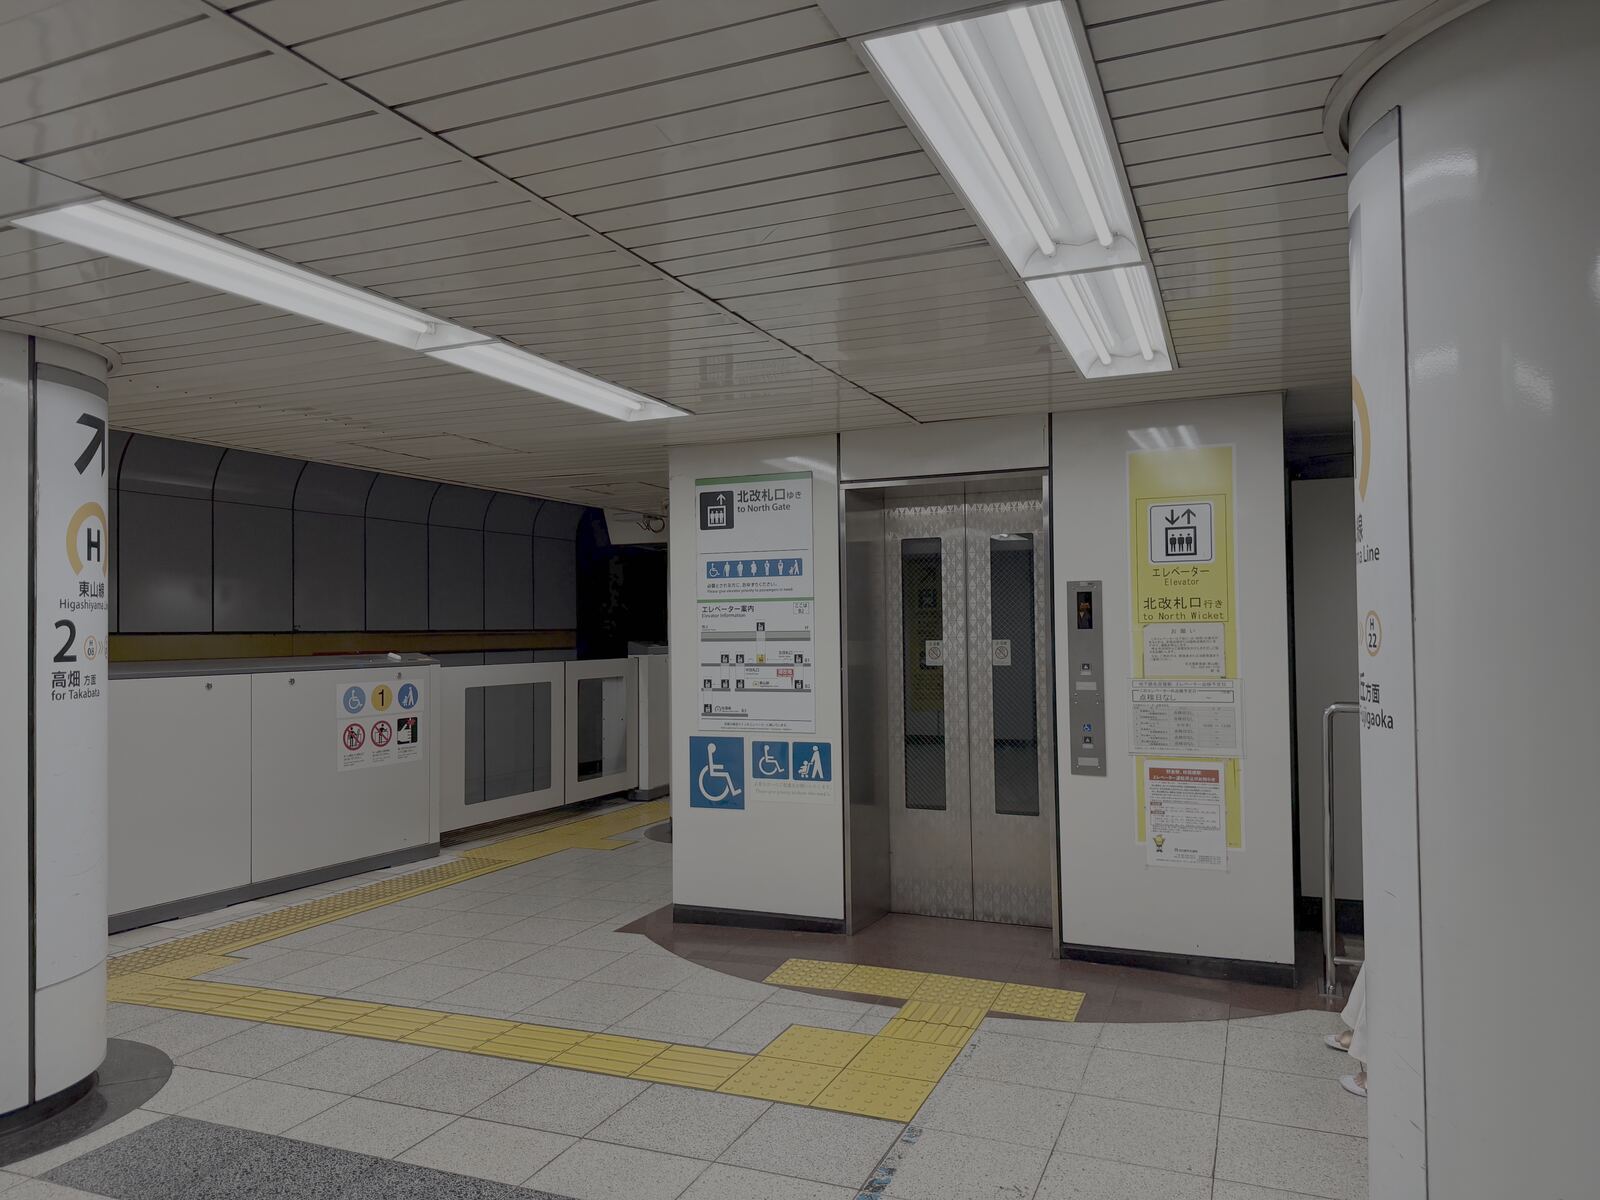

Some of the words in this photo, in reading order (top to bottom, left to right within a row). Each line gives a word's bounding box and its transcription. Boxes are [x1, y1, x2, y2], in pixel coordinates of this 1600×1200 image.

[737, 488, 802, 504] 北改札口ゆき
[747, 504, 770, 512] North
[772, 502, 791, 510] Gate
[87, 528, 100, 562] H
[1363, 544, 1380, 562] Line
[1152, 567, 1210, 577] エレベーター
[1164, 578, 1200, 586] Elevator
[79, 581, 105, 598] 東山線
[702, 605, 755, 613] エレベーター案内
[1144, 596, 1223, 610] 北改札口行き
[1159, 612, 1185, 620] North
[1191, 612, 1223, 620] Wicket
[1369, 618, 1374, 630] H
[54, 619, 78, 663] 2
[1368, 633, 1377, 648] 22
[52, 690, 67, 701] for
[69, 688, 101, 700] Takabata
[378, 689, 385, 706] 1
